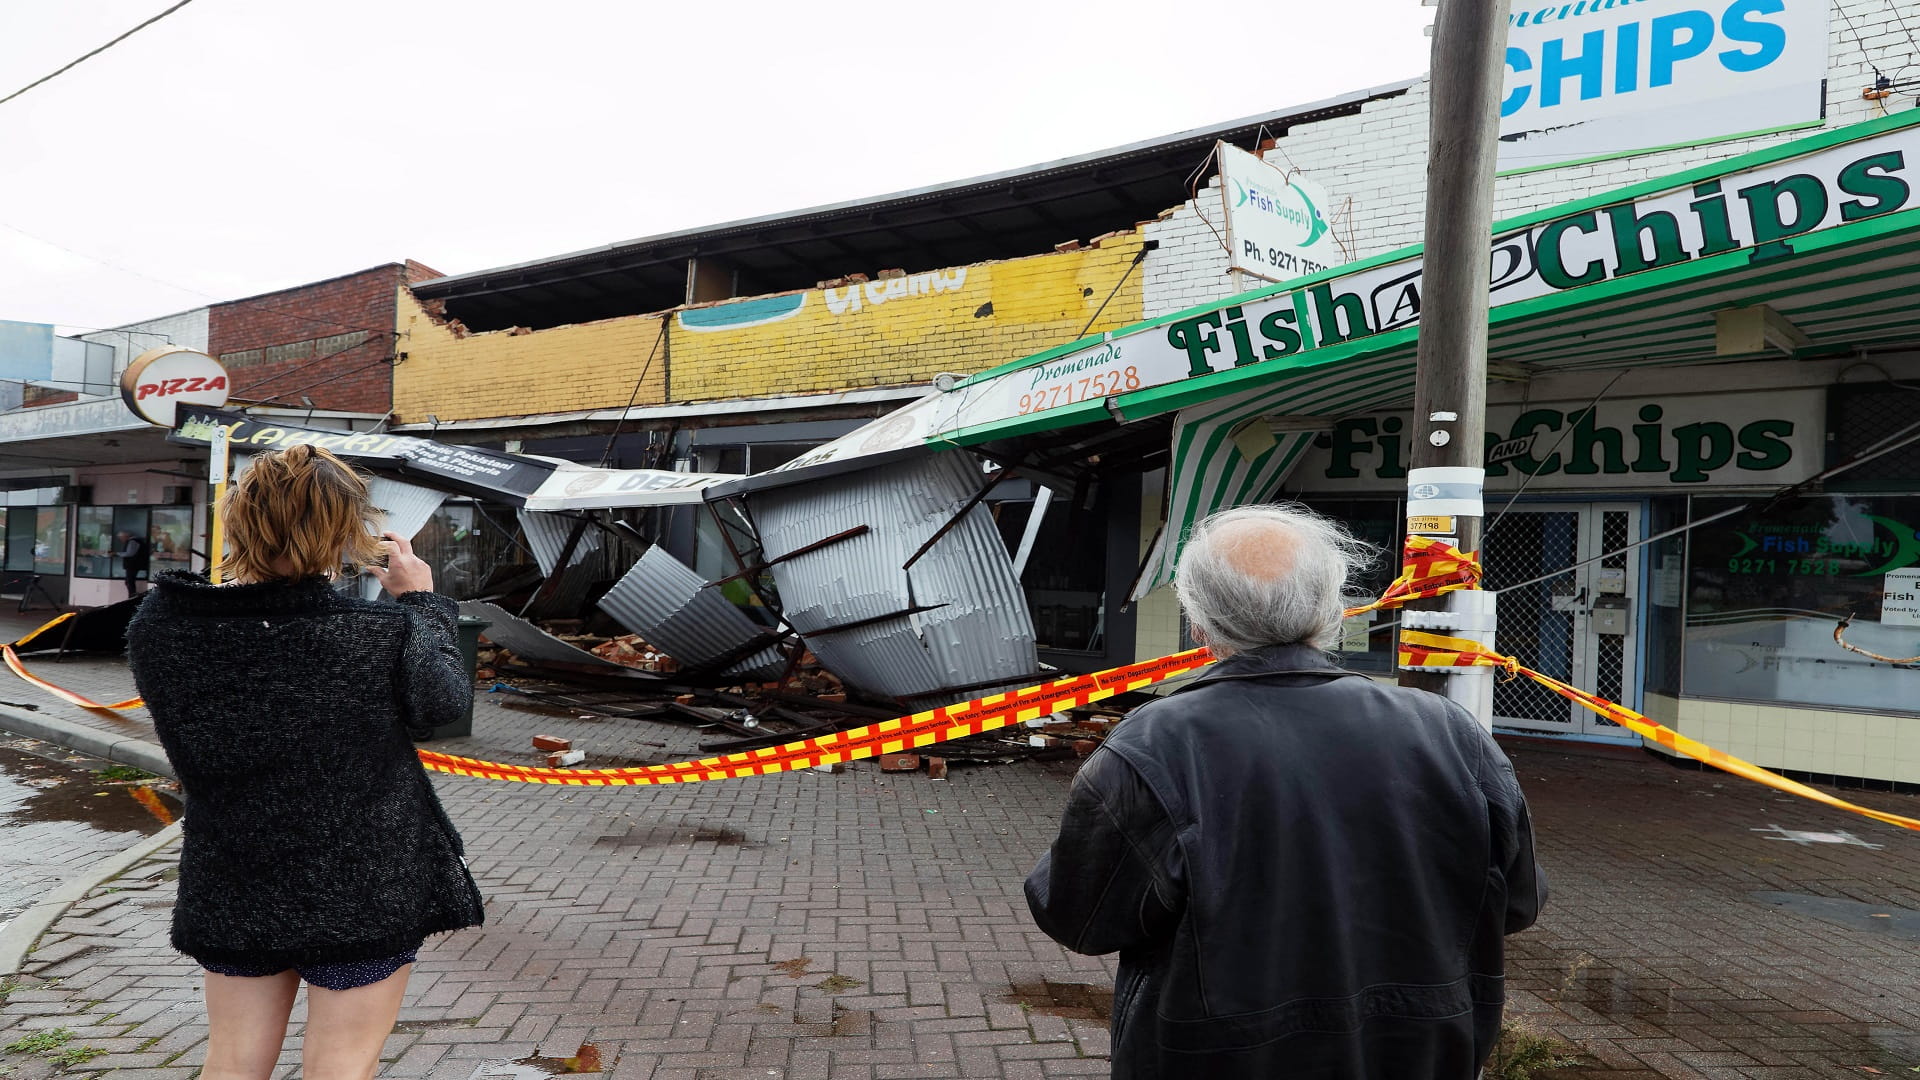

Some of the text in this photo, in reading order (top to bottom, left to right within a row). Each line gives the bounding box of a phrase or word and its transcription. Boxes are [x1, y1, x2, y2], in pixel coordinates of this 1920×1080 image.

[1249, 188, 1310, 231] Fish Supply
[1168, 149, 1912, 378] Fish AD Chips
[1243, 239, 1265, 262] Ph.
[1268, 247, 1299, 274] 9271
[1030, 343, 1122, 391] Promenade
[137, 375, 227, 401] PIZZA
[1492, 439, 1529, 461] AND
[1509, 403, 1795, 484] Chips
[1762, 535, 1895, 558] Fish Supply
[1728, 558, 1840, 575] 9271 7528
[1884, 591, 1915, 601] Fish
[1127, 664, 1161, 679] Department
[1181, 656, 1193, 665] and
[981, 703, 1013, 717] Department
[1019, 698, 1030, 707] Fire
[1030, 695, 1041, 704] and
[1041, 688, 1071, 701] Emergency
[1070, 681, 1095, 693] Services
